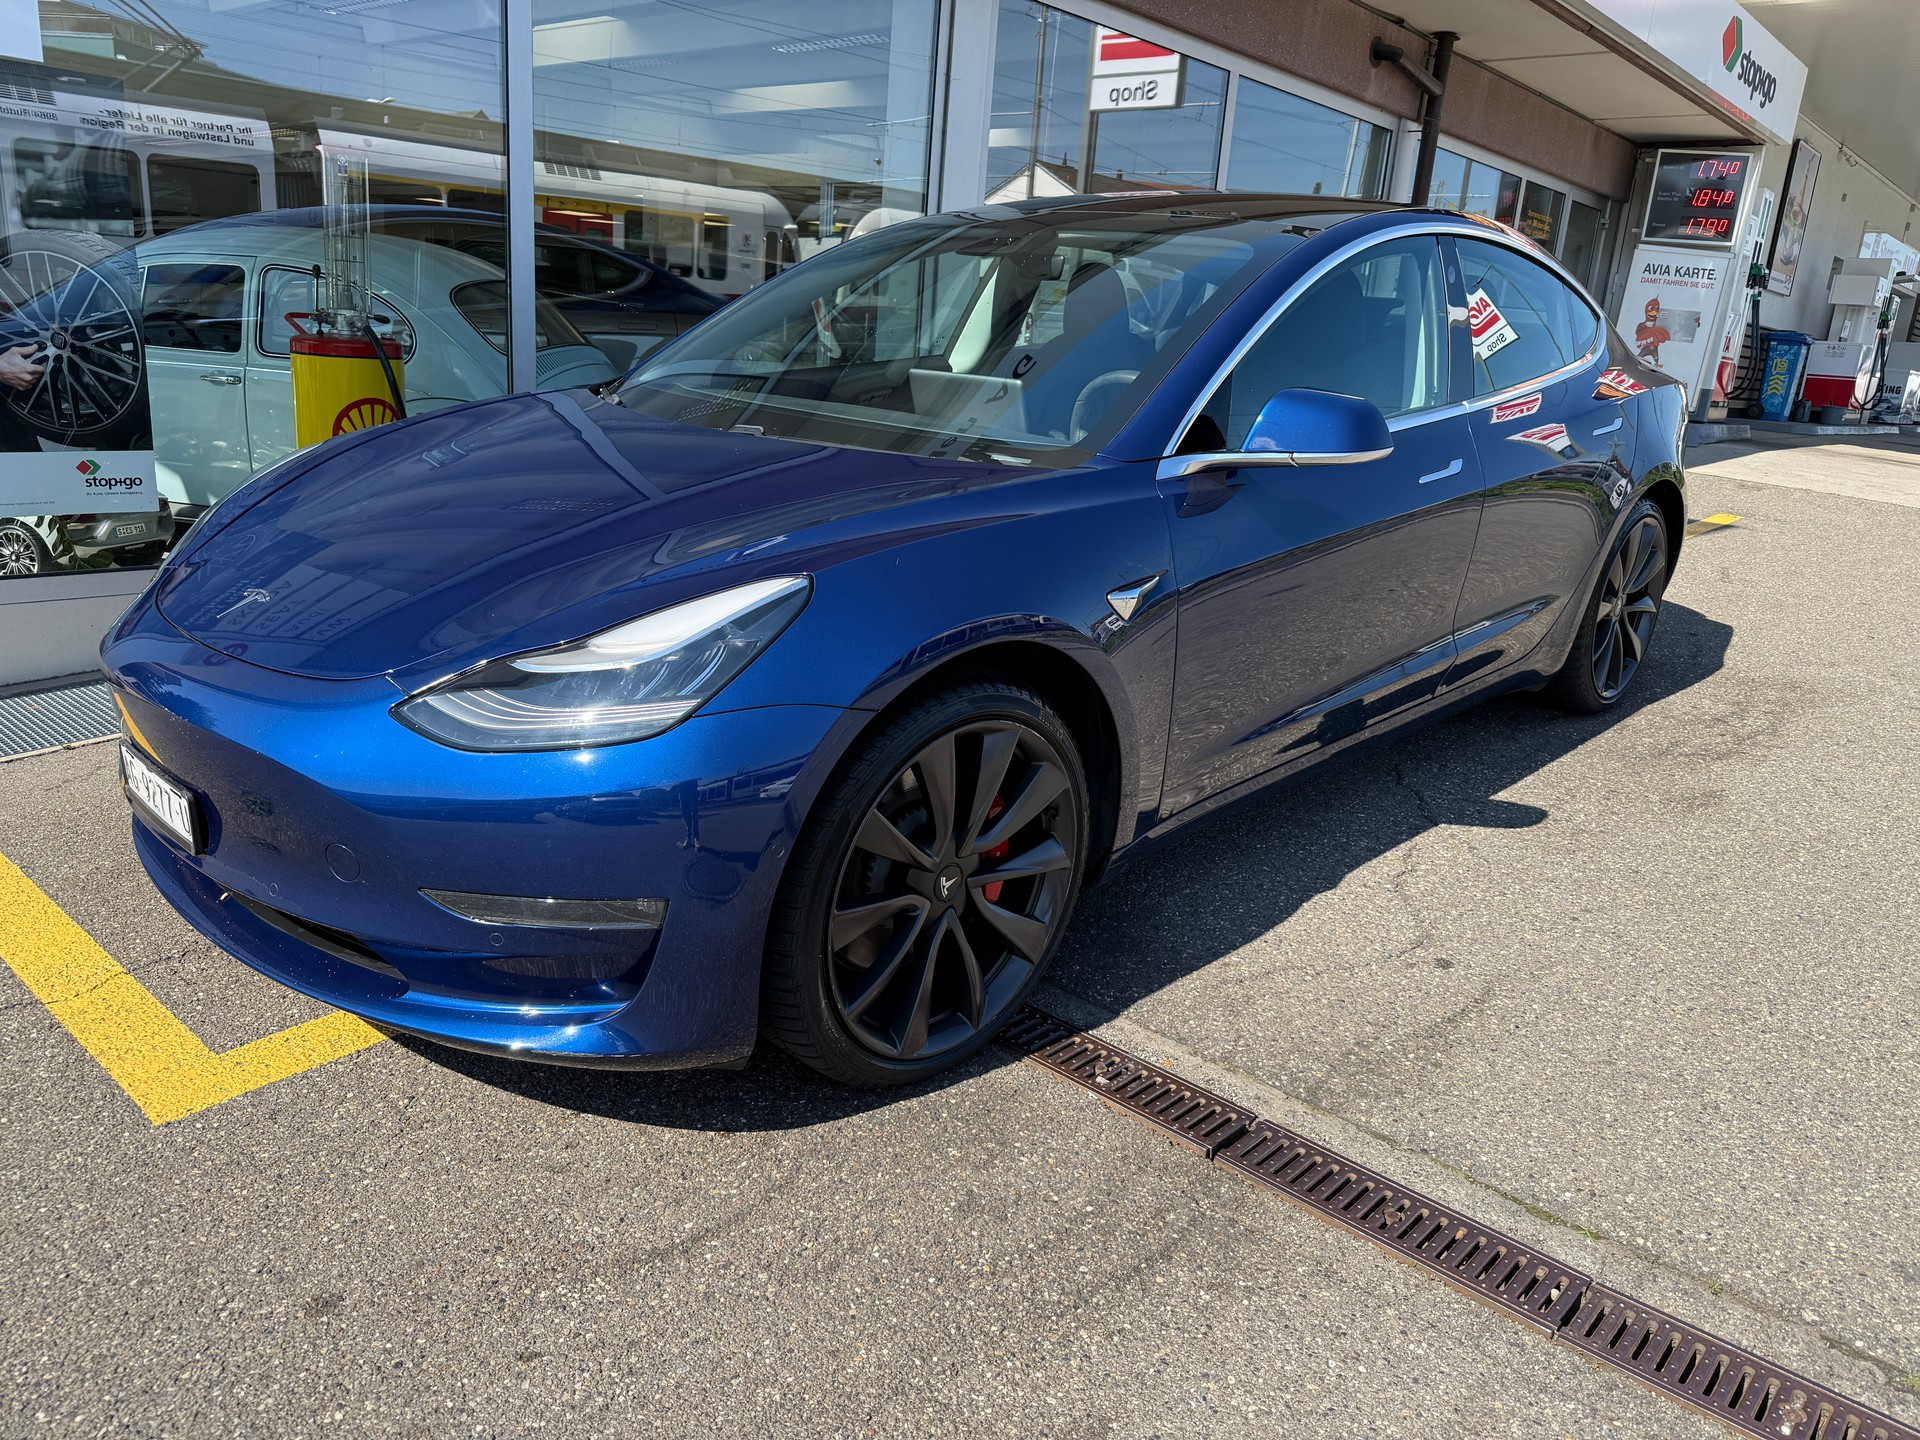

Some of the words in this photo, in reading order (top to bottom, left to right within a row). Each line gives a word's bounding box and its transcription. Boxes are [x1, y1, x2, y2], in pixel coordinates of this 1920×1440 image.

[1737, 50, 1777, 109] stop+go
[1642, 262, 1671, 277] AVIA
[1674, 265, 1717, 281] KARTE.
[1640, 276, 1662, 285] DAMIT
[1662, 278, 1688, 287] FAHREN
[1700, 282, 1715, 290] GUT.
[85, 475, 143, 490] stop+go
